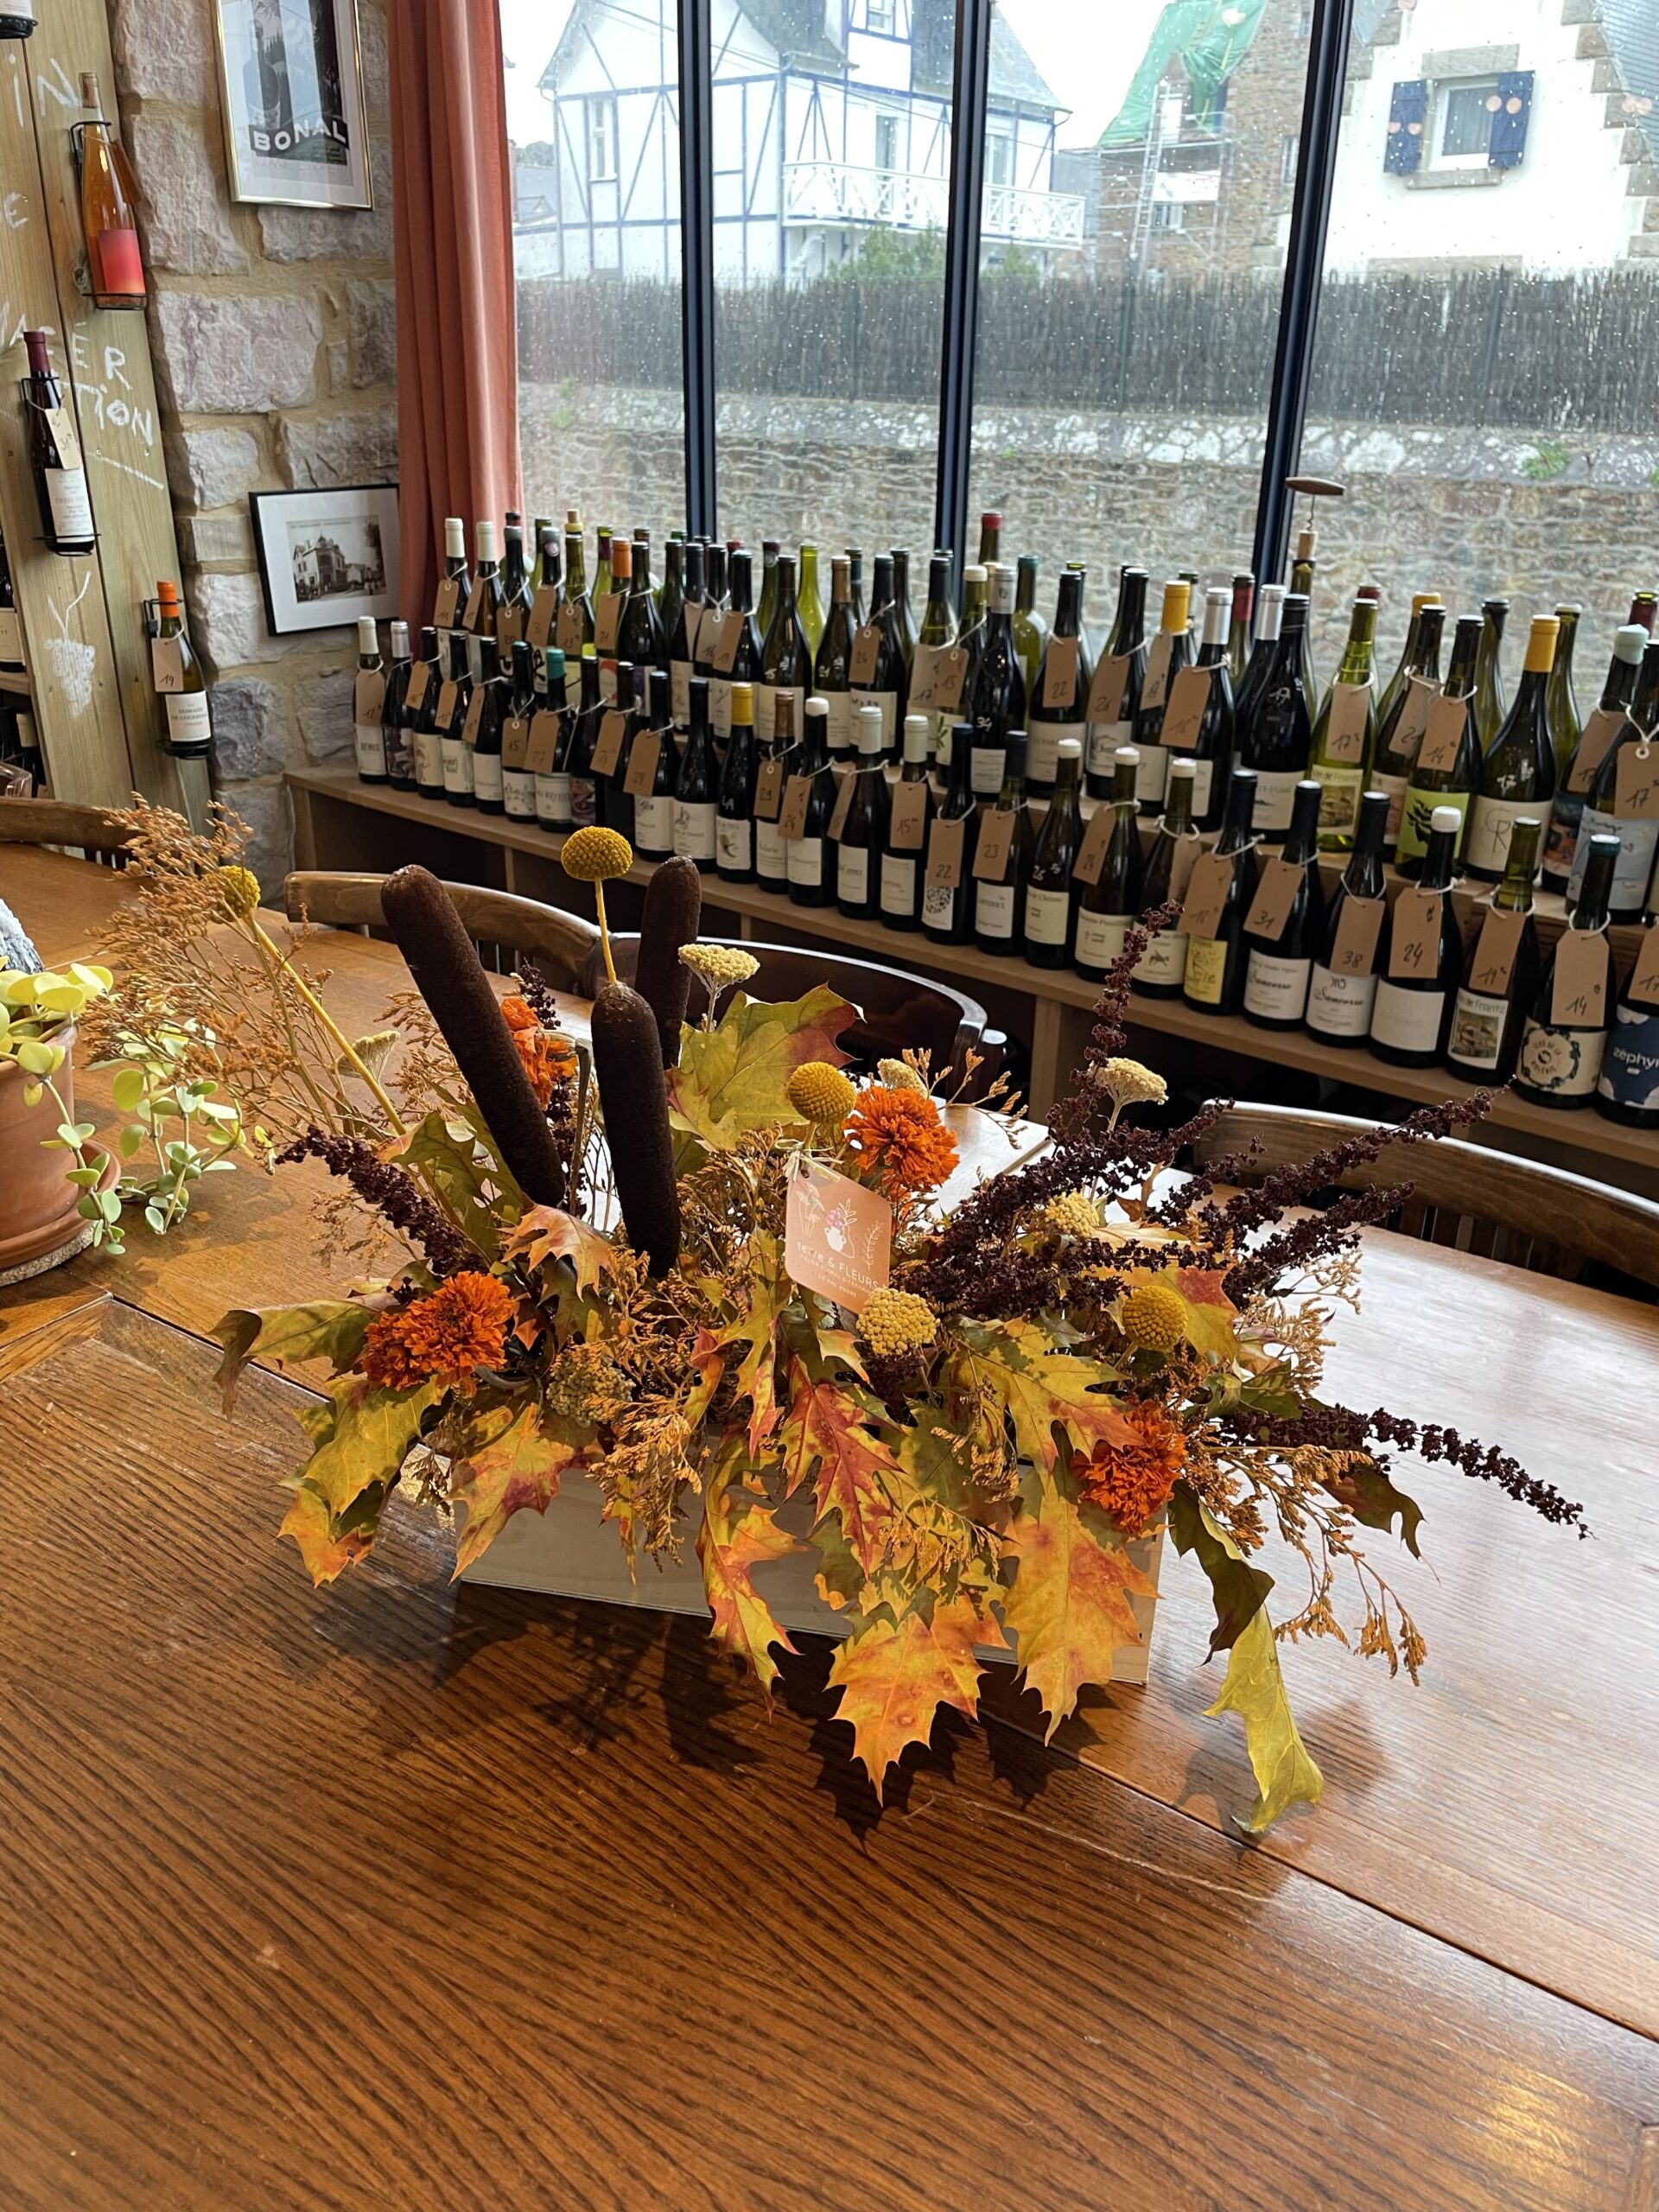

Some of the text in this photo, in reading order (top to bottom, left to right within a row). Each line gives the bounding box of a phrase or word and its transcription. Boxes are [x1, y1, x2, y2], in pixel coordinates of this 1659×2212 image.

[252, 118, 346, 151] BONAL
[1403, 942, 1424, 968] 24
[839, 1263, 880, 1289] FLEURS
